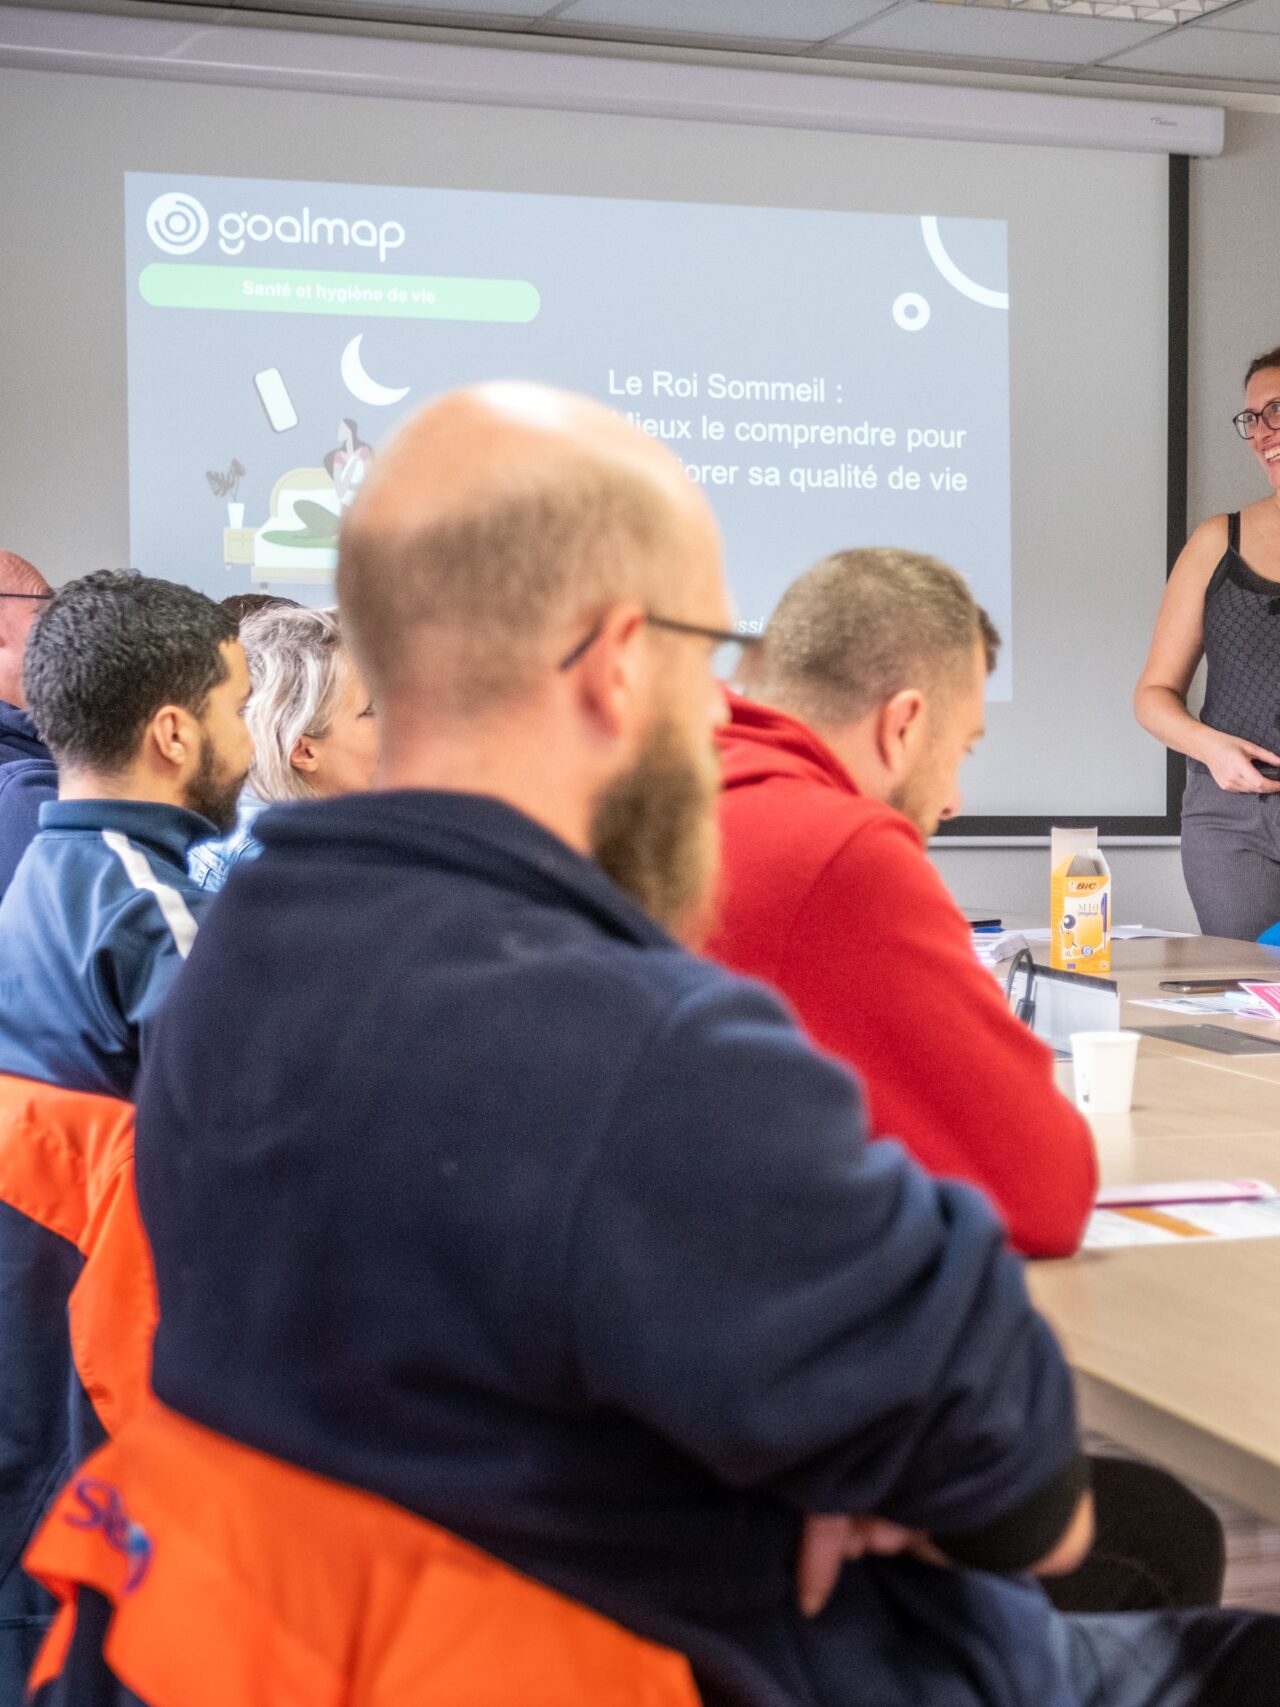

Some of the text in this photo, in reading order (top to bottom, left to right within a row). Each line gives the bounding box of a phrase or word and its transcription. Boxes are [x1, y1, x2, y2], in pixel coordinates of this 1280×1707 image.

[218, 208, 405, 262] goalmap
[242, 280, 292, 298] Santé
[296, 284, 312, 298] et
[387, 287, 408, 303] de
[411, 288, 437, 304] vie
[608, 369, 642, 395] Le
[652, 371, 699, 398] Roi
[706, 373, 826, 403] Sommeil
[701, 414, 725, 440] le
[734, 418, 896, 449] comprendre
[906, 427, 967, 454] pour
[748, 465, 780, 487] sa
[789, 463, 878, 493] qualité
[887, 467, 921, 490] de
[928, 468, 968, 492] vie
